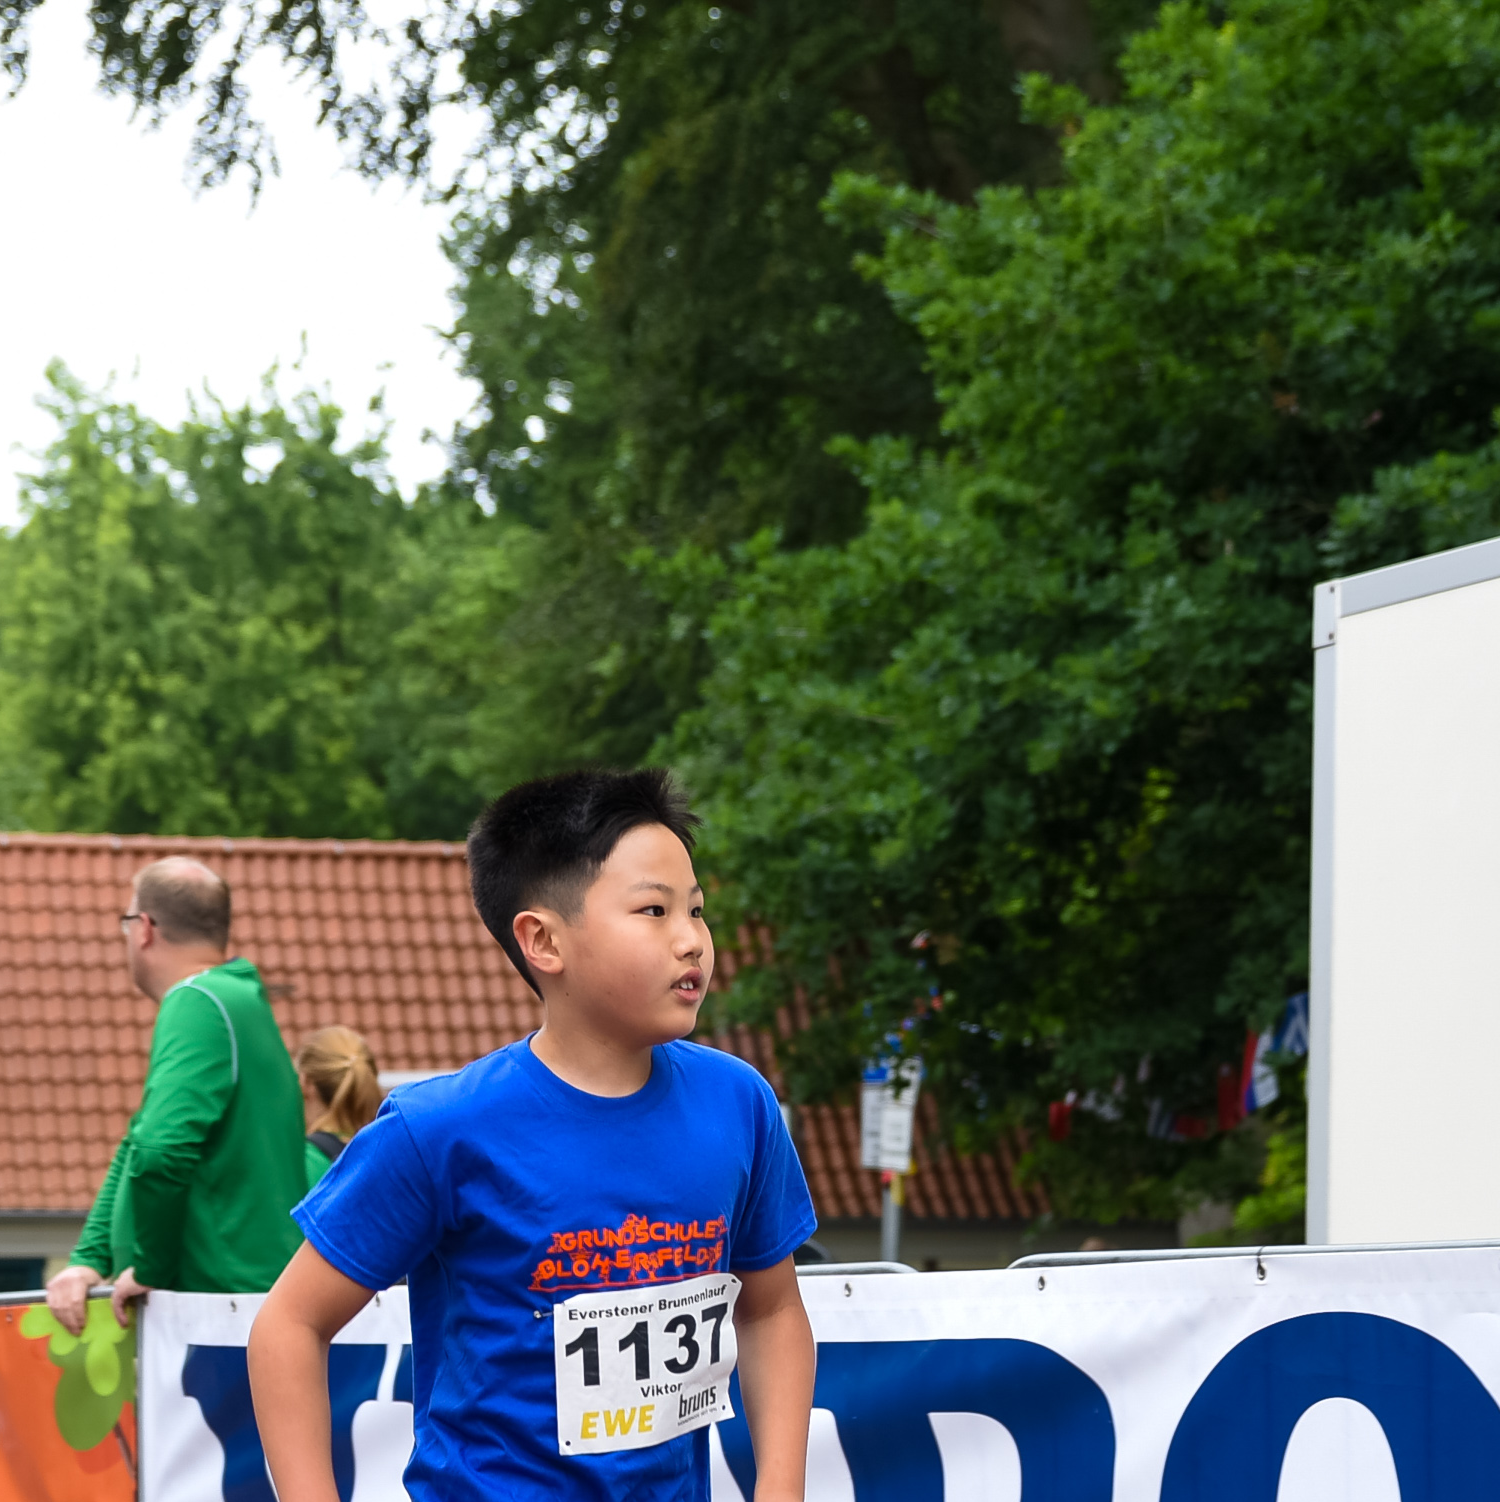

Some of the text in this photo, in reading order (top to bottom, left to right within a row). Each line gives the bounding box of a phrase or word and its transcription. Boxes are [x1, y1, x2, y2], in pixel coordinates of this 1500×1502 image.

[568, 1284, 728, 1321] Everstener Brunnenlauf
[565, 1302, 729, 1387] 1137
[640, 1381, 683, 1400] Viktor
[678, 1386, 717, 1419] bruns
[580, 1404, 656, 1440] EWE
